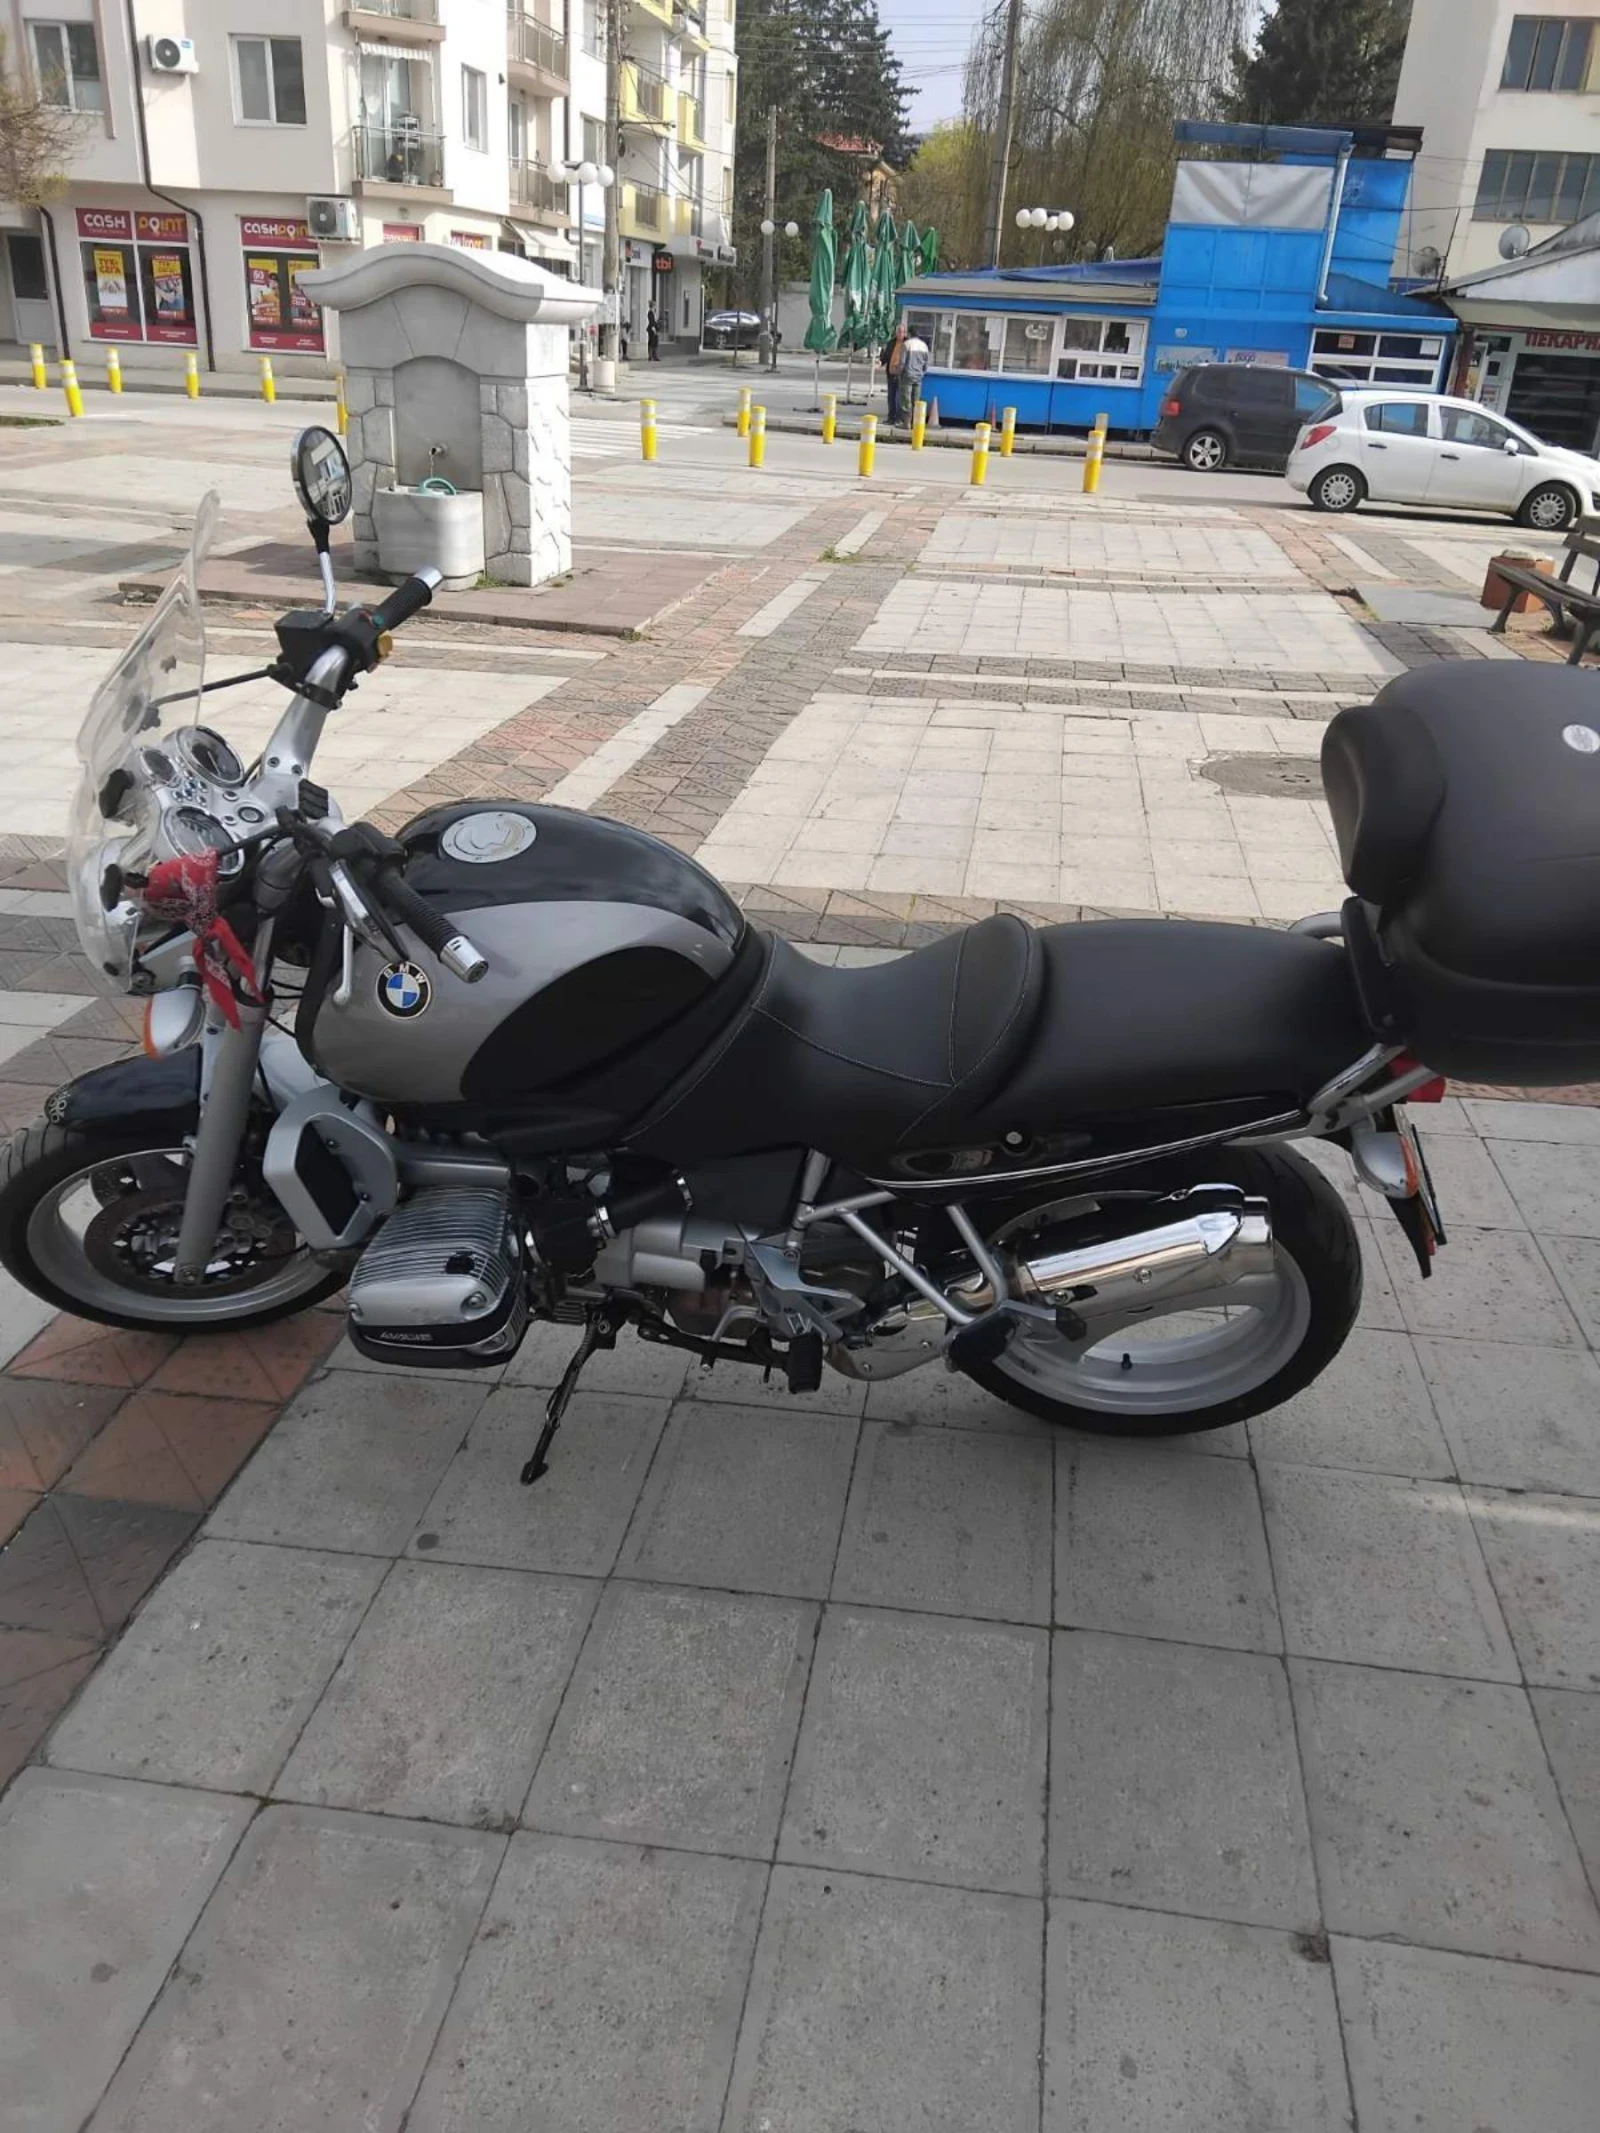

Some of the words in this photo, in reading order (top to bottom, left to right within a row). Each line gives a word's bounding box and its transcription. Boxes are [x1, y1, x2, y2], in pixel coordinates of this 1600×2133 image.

[84, 214, 126, 229] CASH
[139, 216, 184, 233] POINT
[656, 257, 672, 270] tbi
[383, 964, 426, 983] BMW
